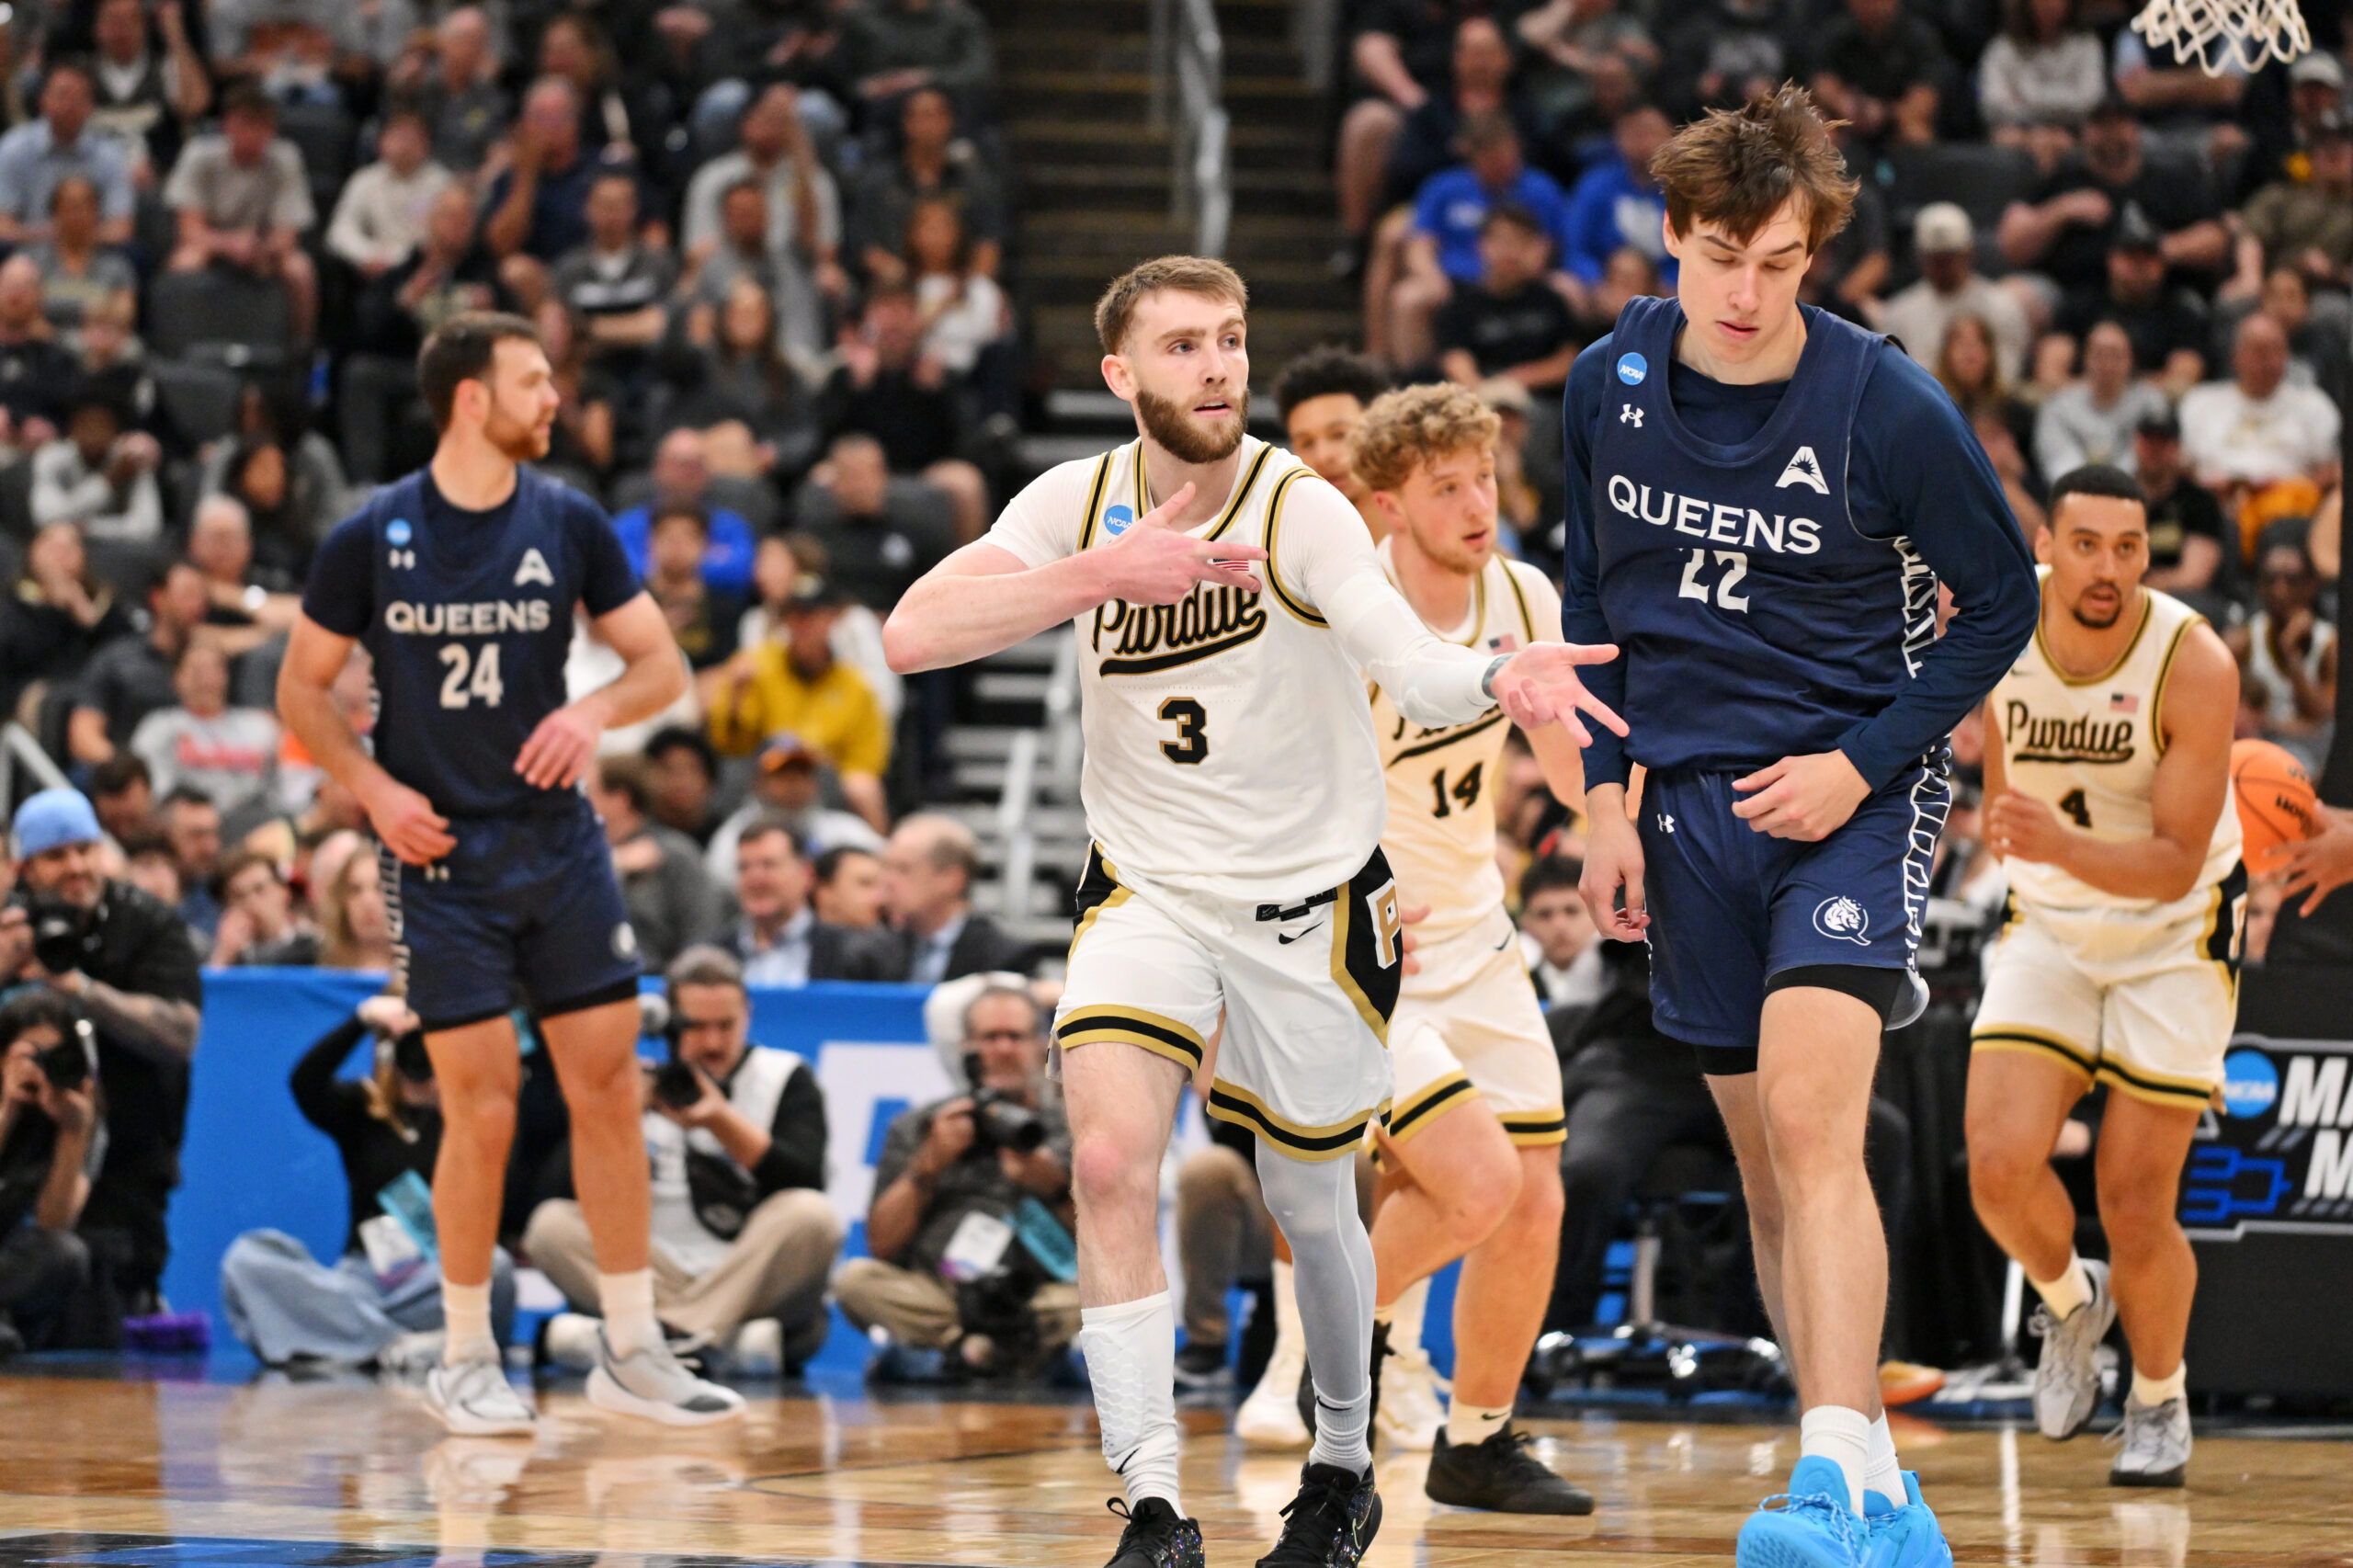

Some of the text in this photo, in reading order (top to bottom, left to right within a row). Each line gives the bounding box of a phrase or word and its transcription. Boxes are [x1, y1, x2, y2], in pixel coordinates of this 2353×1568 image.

[1620, 364, 1644, 381] NCAA
[1608, 474, 1823, 554] QUEENS
[385, 599, 551, 635] QUEENS
[438, 642, 504, 709] 24
[1157, 696, 1210, 766] 3
[2006, 699, 2133, 755] Purdue
[1430, 761, 1484, 818] 14
[2059, 788, 2093, 829] 4
